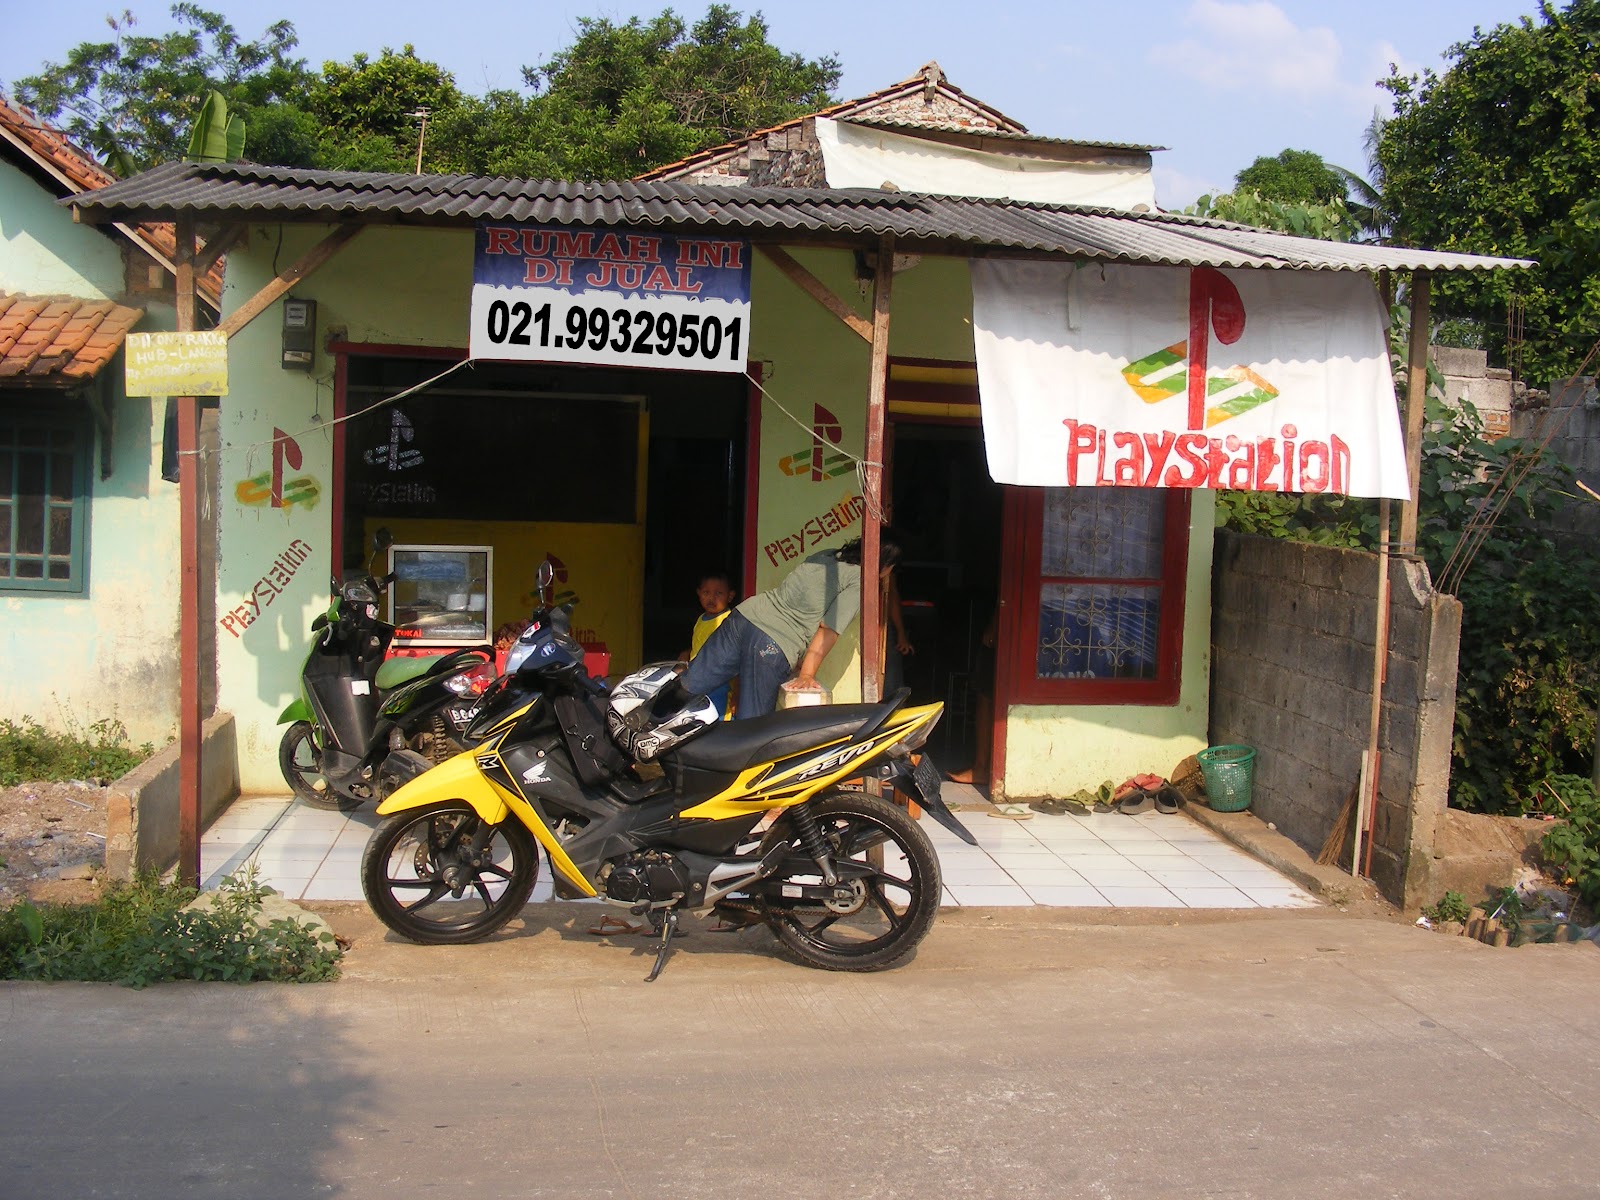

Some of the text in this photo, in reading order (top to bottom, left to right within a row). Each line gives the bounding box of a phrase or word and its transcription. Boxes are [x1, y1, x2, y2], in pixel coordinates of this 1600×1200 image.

[485, 226, 743, 269] RUMAH INI
[523, 258, 704, 294] DI JUAL
[487, 299, 742, 361] 021.99329501
[523, 776, 552, 785] HONDA
[797, 741, 876, 781] REVO
